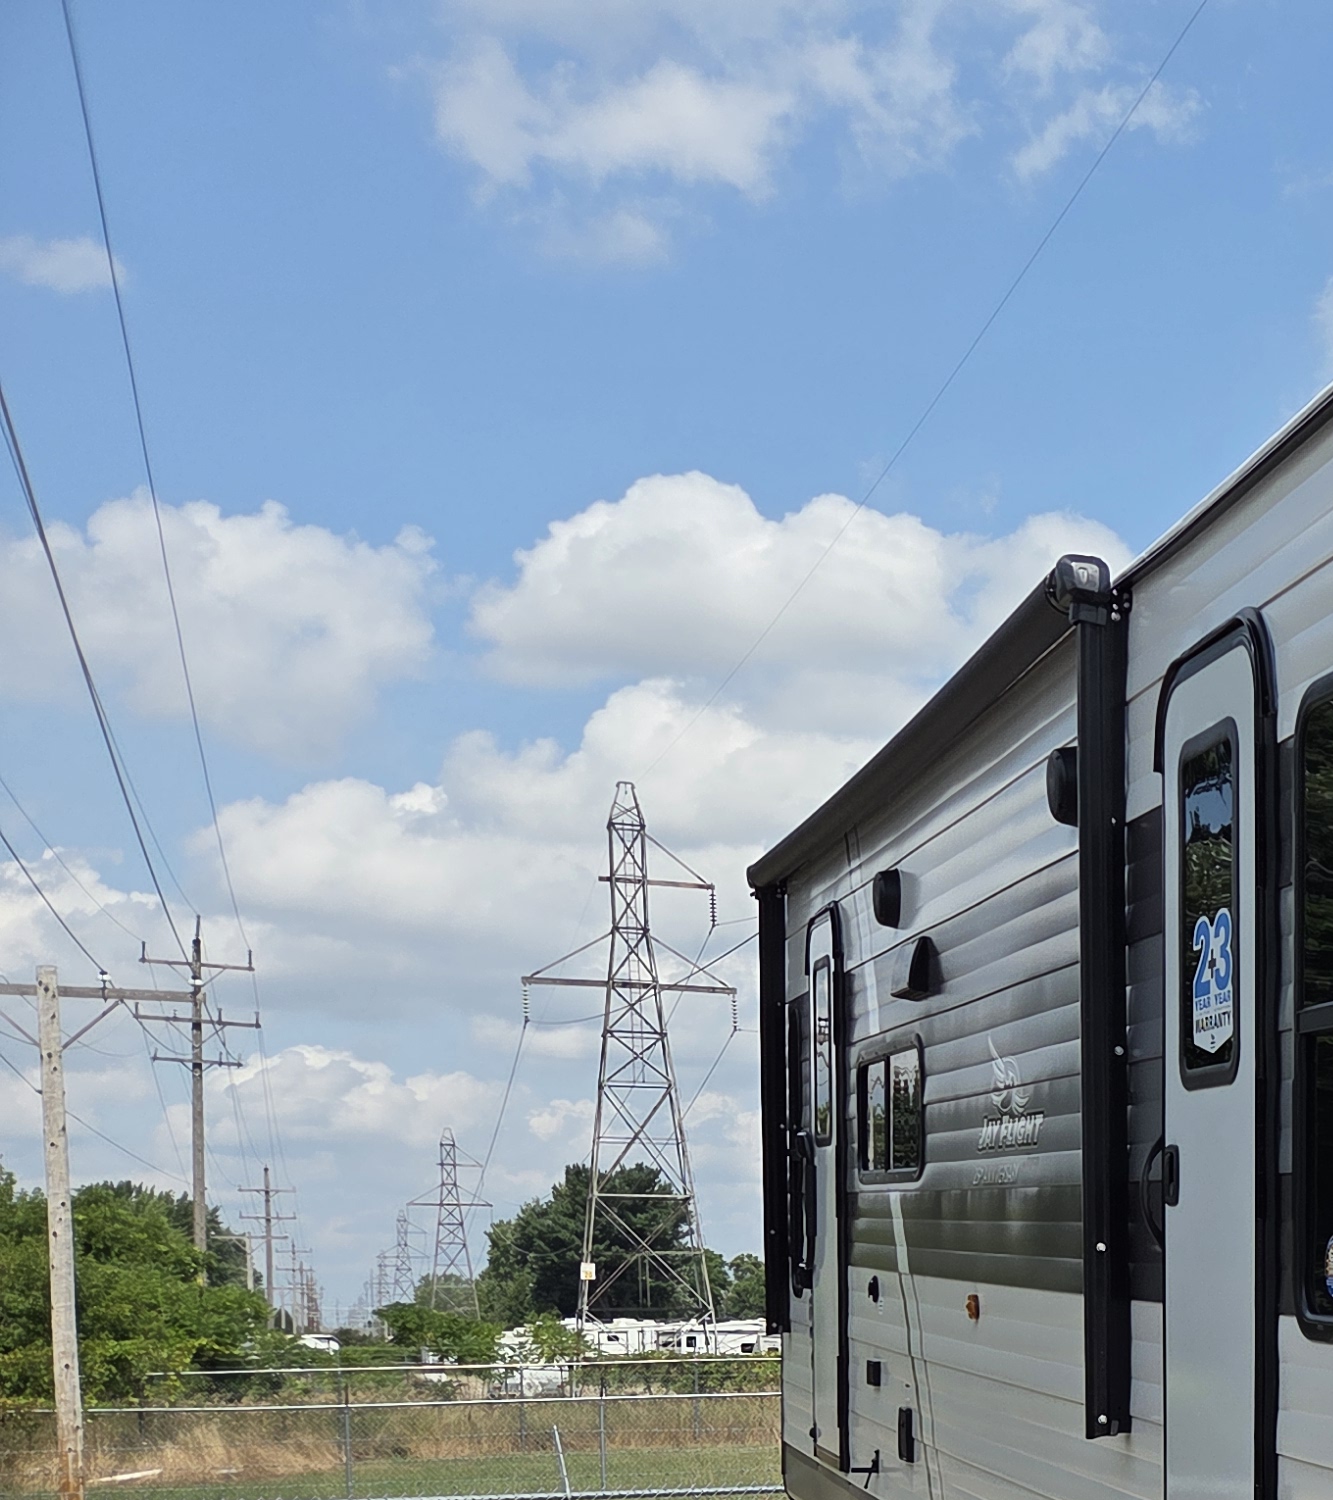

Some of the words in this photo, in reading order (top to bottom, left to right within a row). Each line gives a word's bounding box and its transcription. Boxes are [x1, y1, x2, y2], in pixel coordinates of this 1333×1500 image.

[1195, 1010, 1231, 1034] WARRANTY
[978, 1116, 1001, 1151] JAY
[999, 1110, 1045, 1149] FLIGHT
